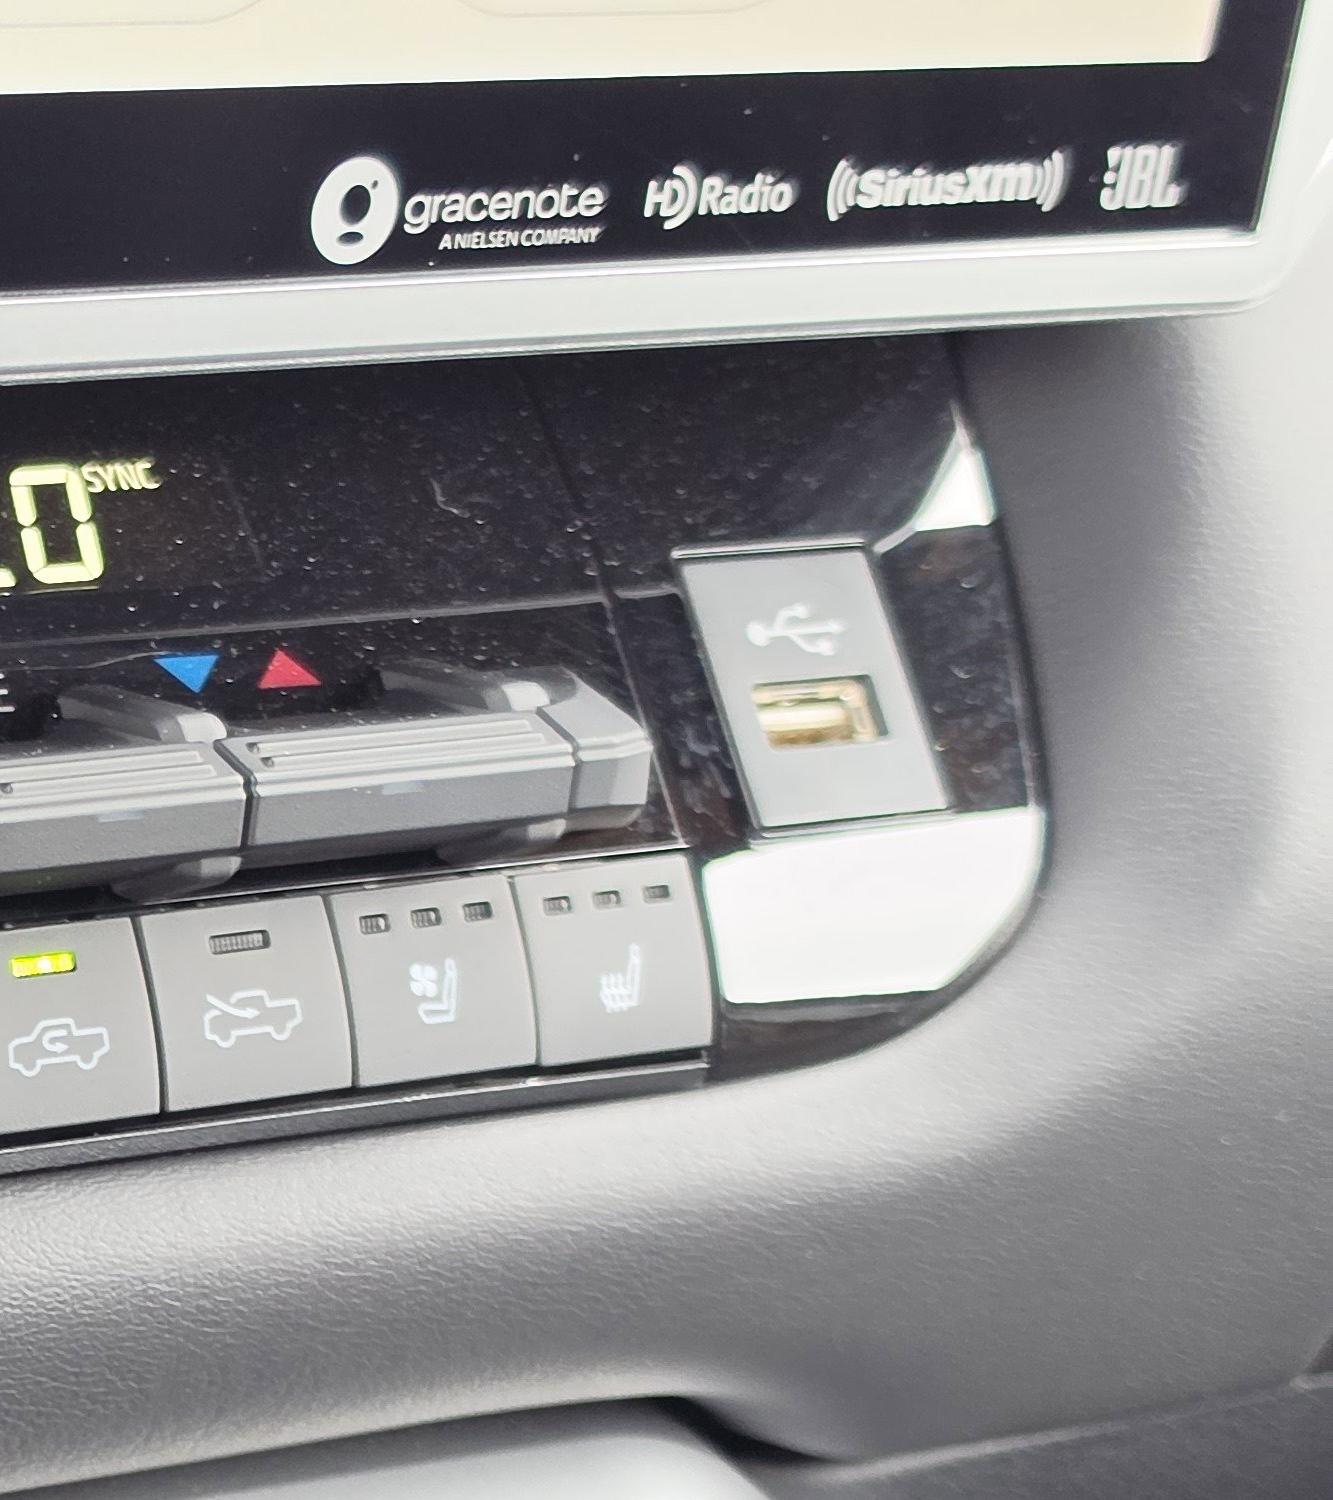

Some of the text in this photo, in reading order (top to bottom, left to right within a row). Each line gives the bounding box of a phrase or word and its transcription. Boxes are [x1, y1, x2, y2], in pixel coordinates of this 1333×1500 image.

[699, 172, 794, 216] Radio
[1100, 143, 1179, 210] JBL
[403, 183, 607, 235] gracenote
[437, 226, 603, 250] A NIELSEN COMPANY
[81, 460, 162, 493] SYNC
